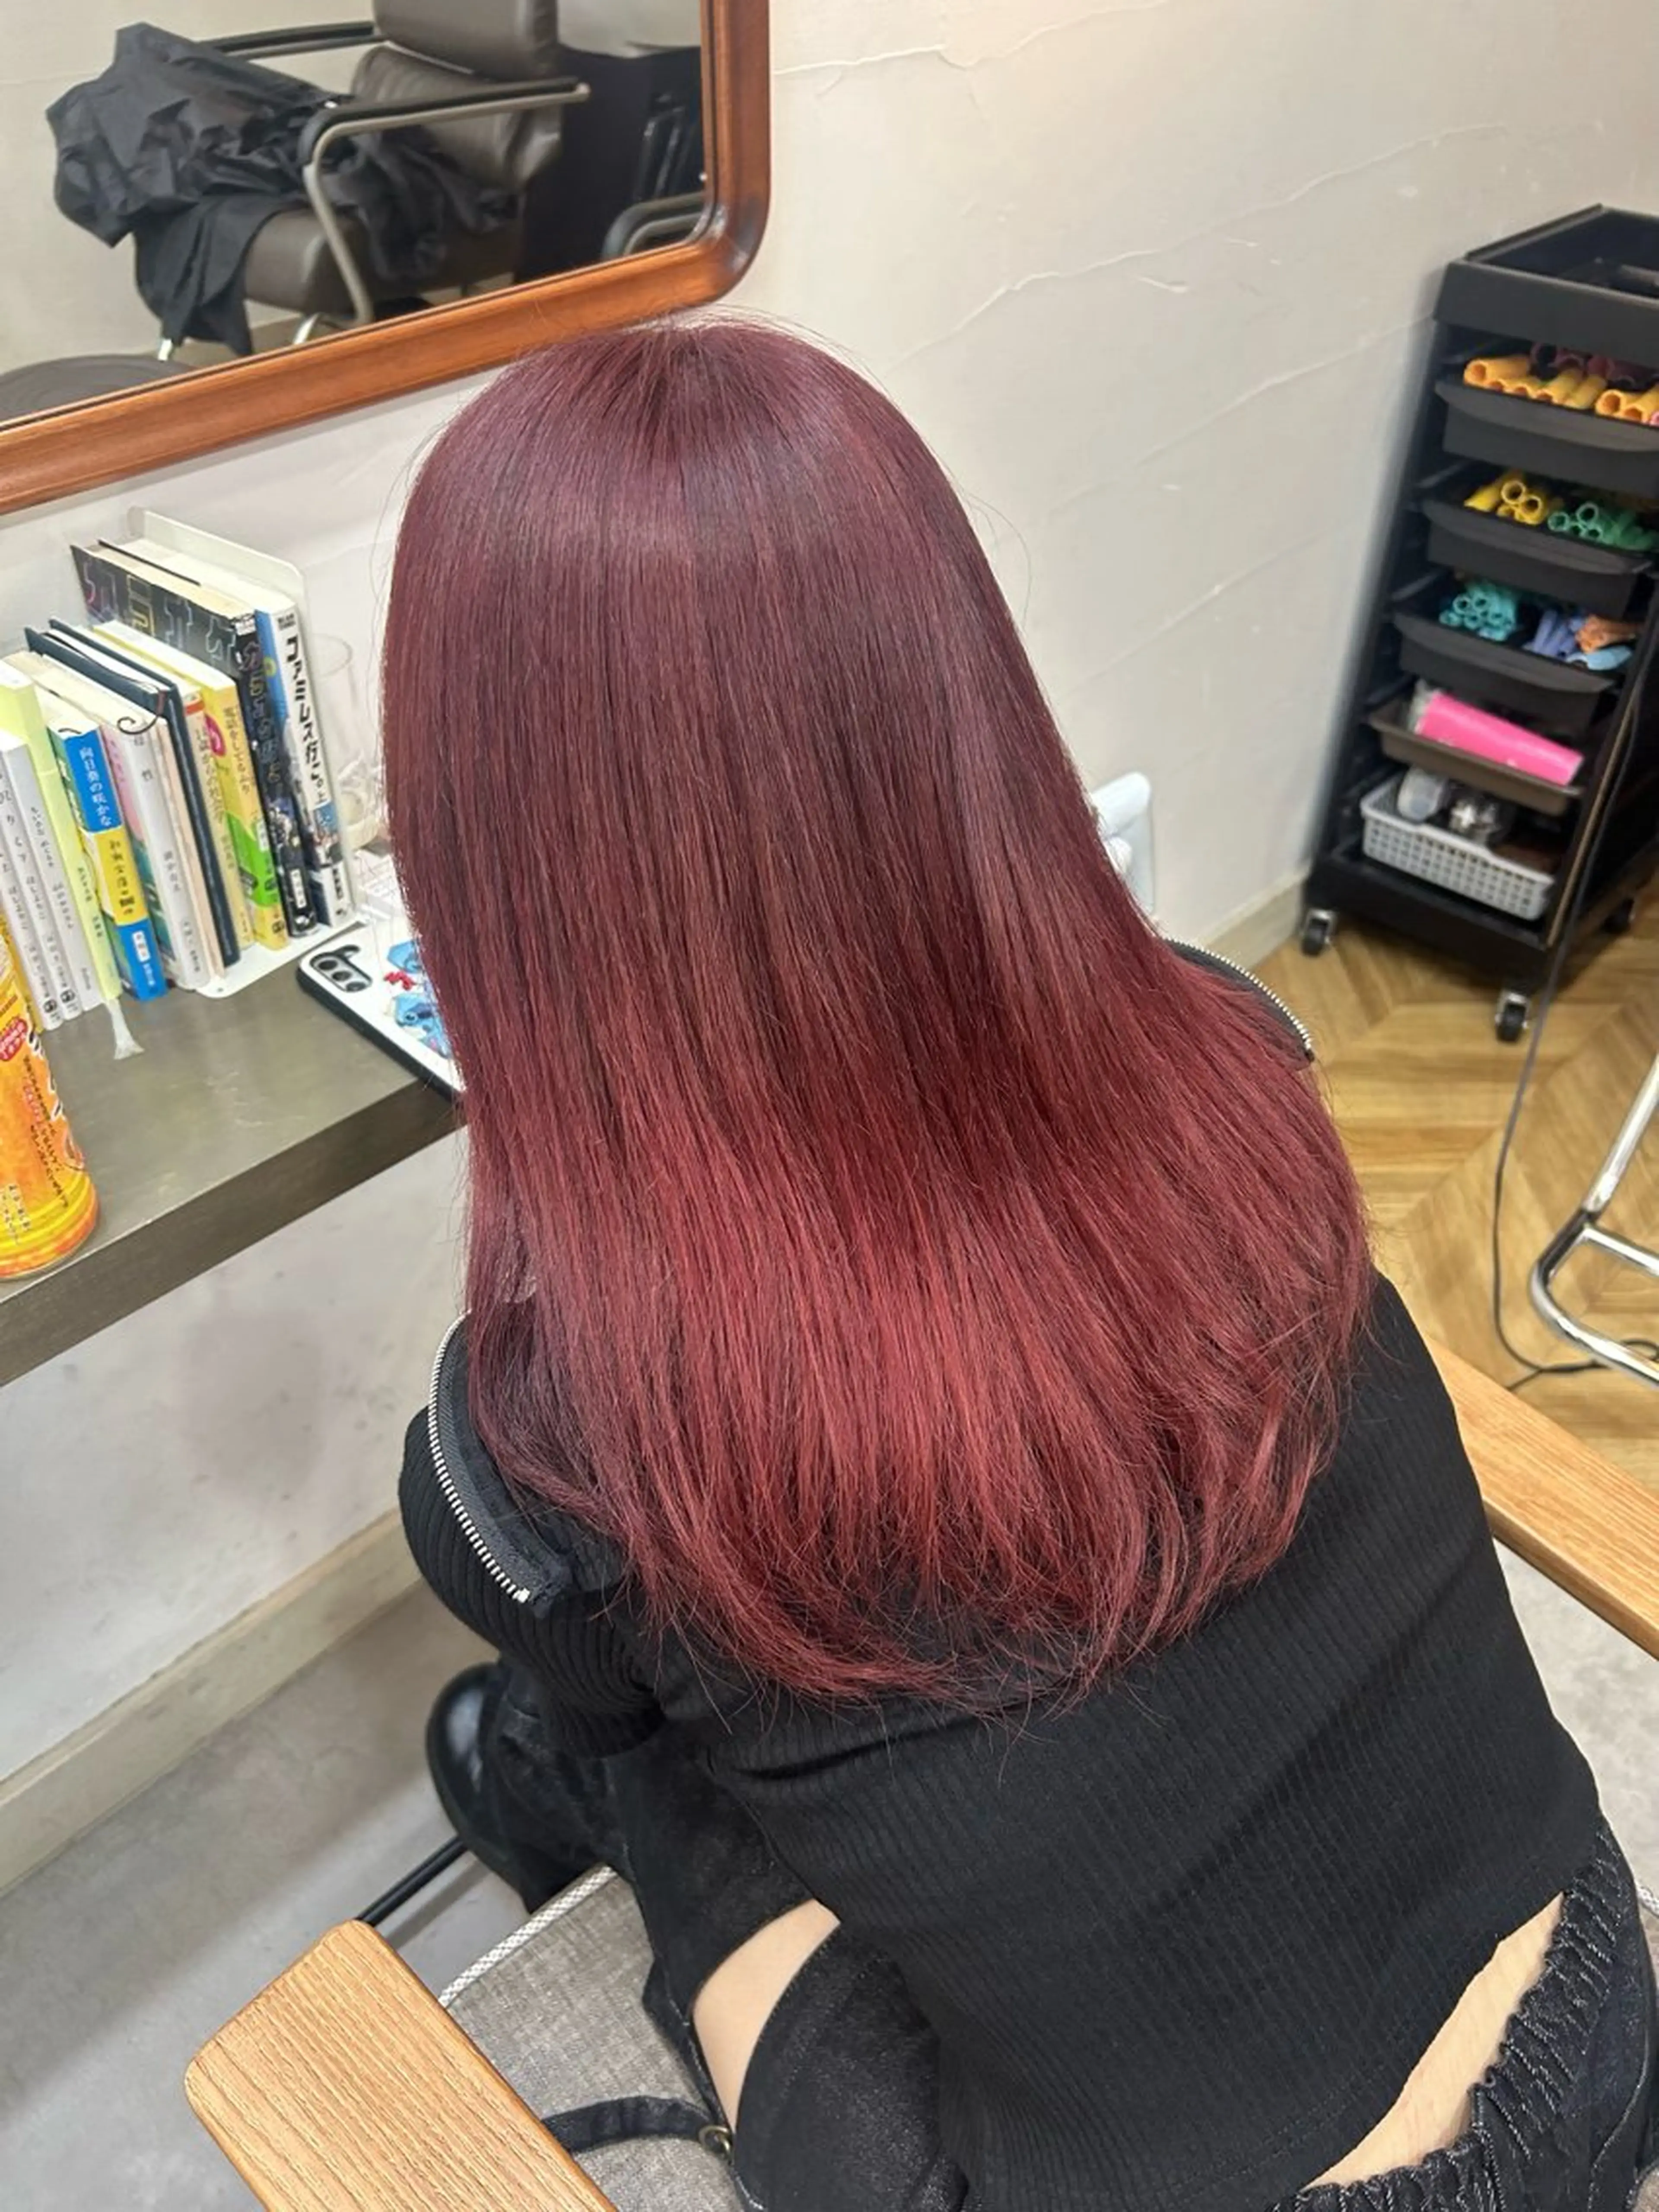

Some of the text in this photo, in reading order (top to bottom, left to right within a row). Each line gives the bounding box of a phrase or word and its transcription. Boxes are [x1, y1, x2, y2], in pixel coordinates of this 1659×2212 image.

[79, 746, 112, 826] 向日葵の咲かな
